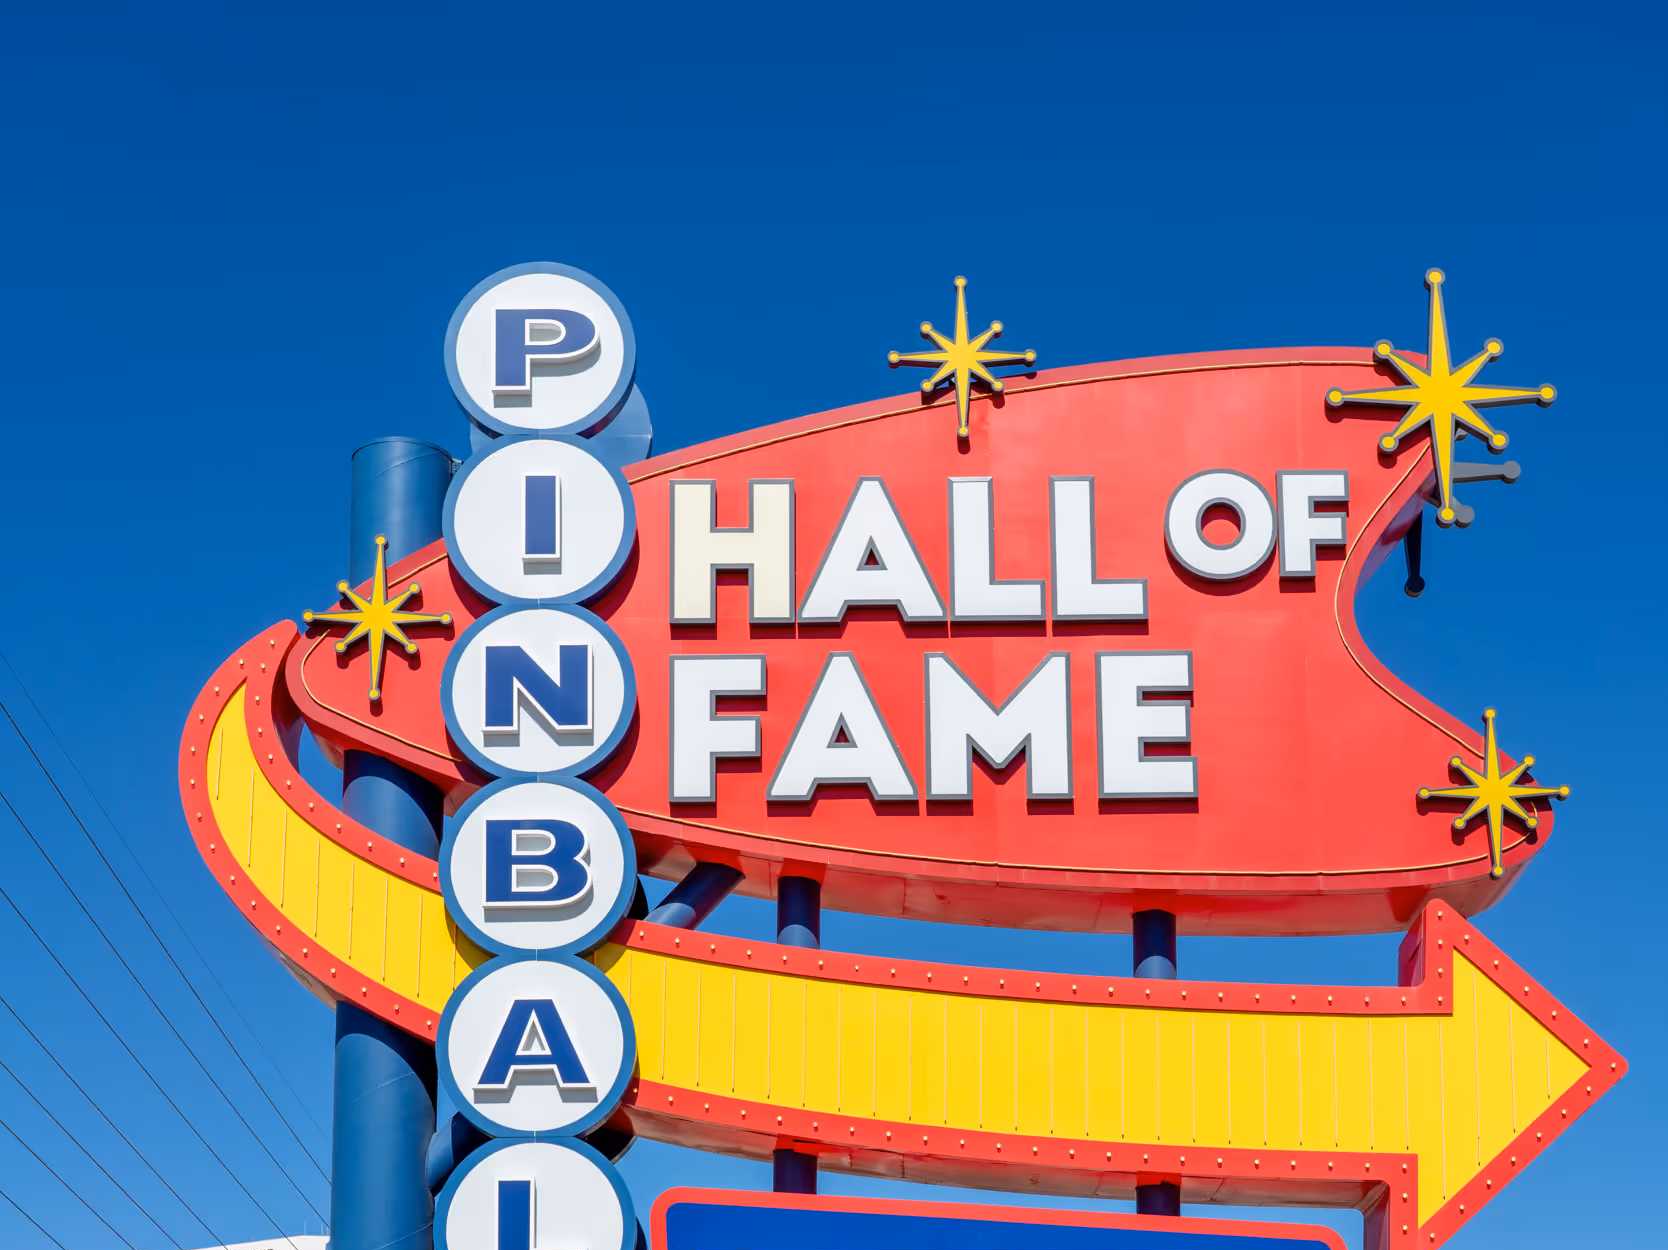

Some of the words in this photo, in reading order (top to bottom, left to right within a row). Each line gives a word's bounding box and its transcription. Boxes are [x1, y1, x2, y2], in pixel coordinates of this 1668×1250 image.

[669, 475, 1149, 626] HALL
[1164, 468, 1350, 582] OF
[669, 650, 1200, 803] FAME
